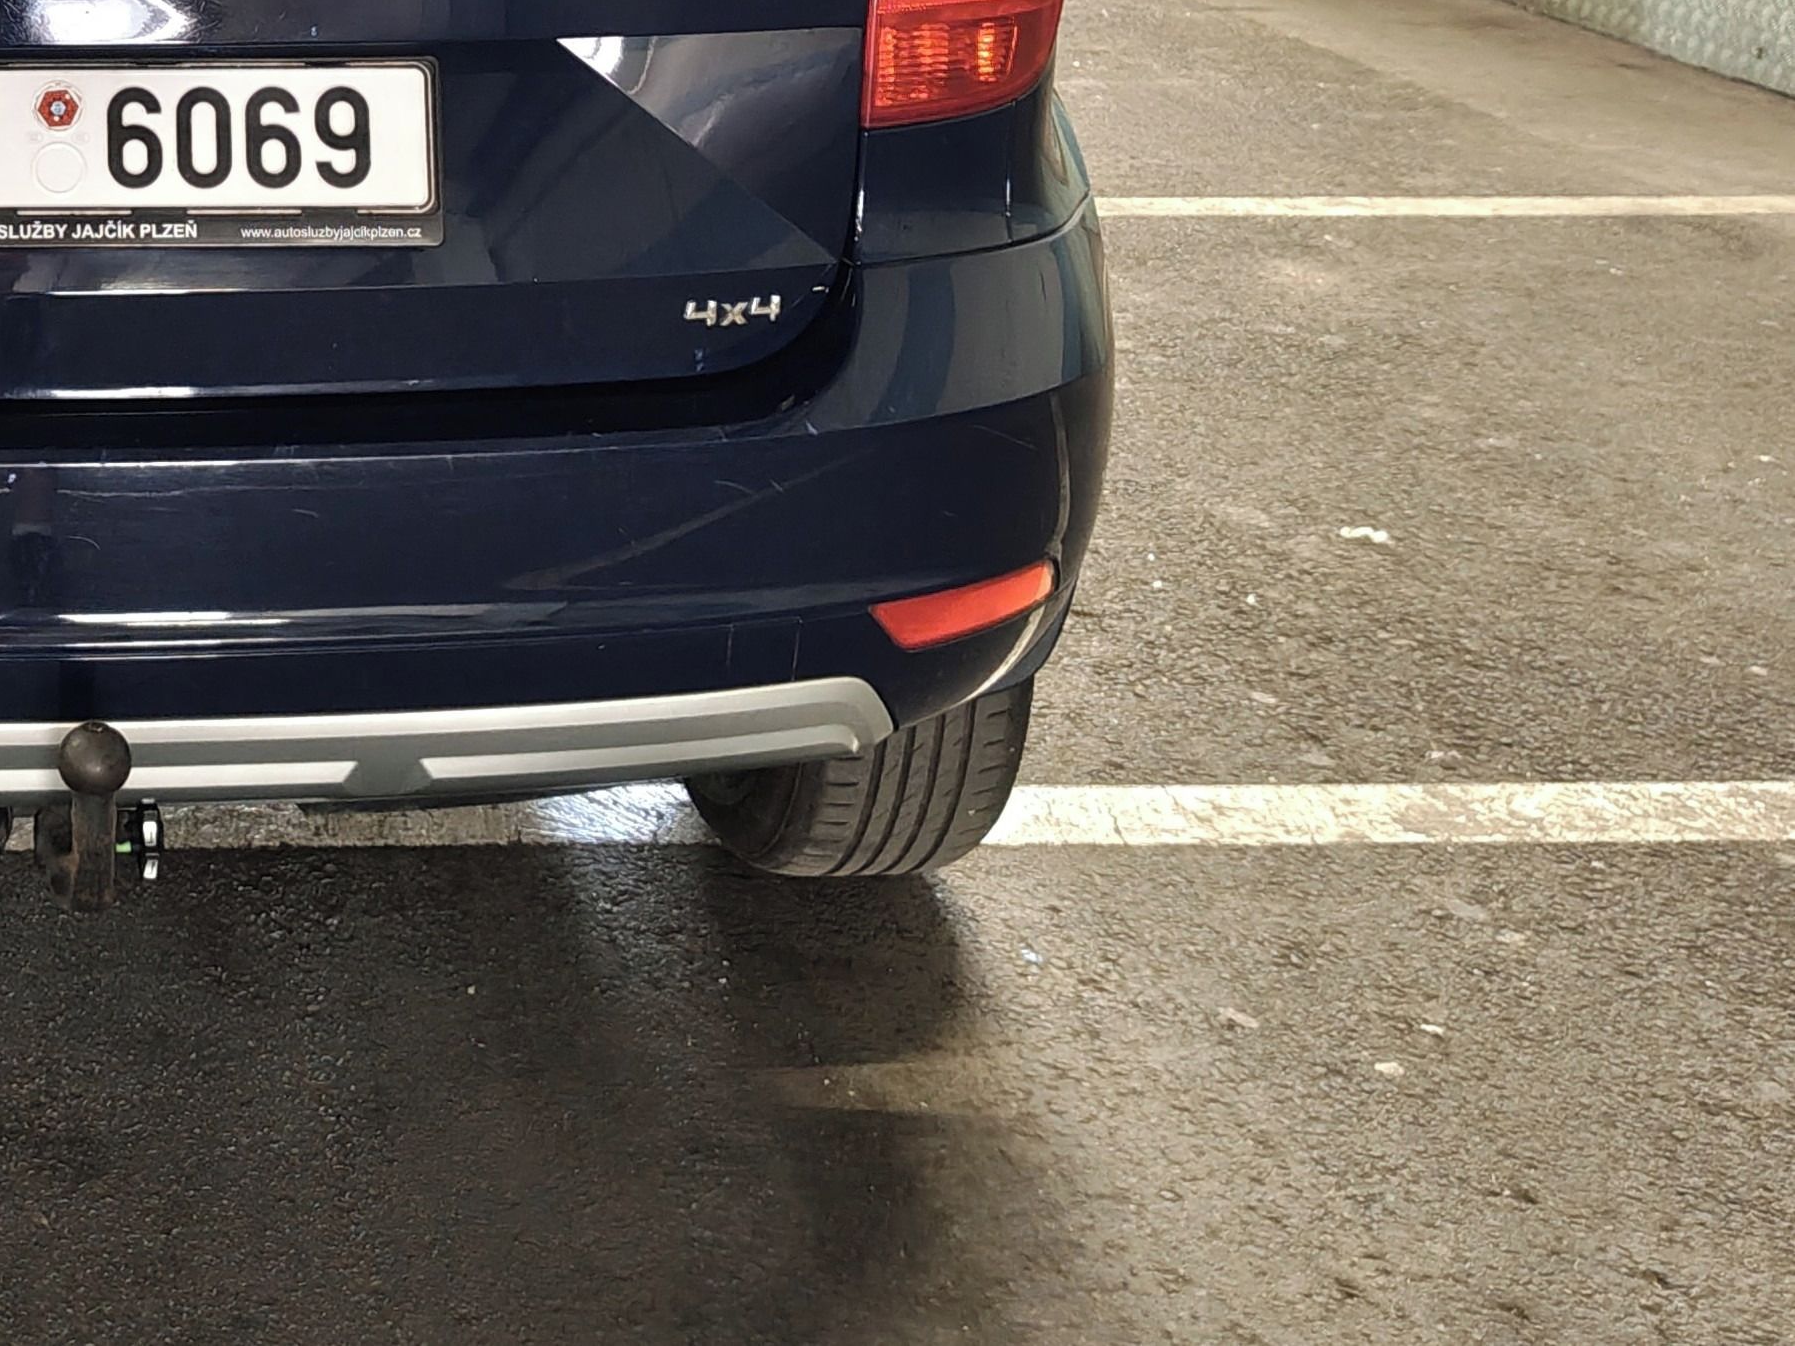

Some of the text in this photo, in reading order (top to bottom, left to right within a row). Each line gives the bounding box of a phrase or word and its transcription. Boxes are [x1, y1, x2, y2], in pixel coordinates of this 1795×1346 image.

[106, 86, 372, 190] 6069
[71, 220, 136, 240] JAJČÍK
[139, 219, 198, 239] PLZEŇ
